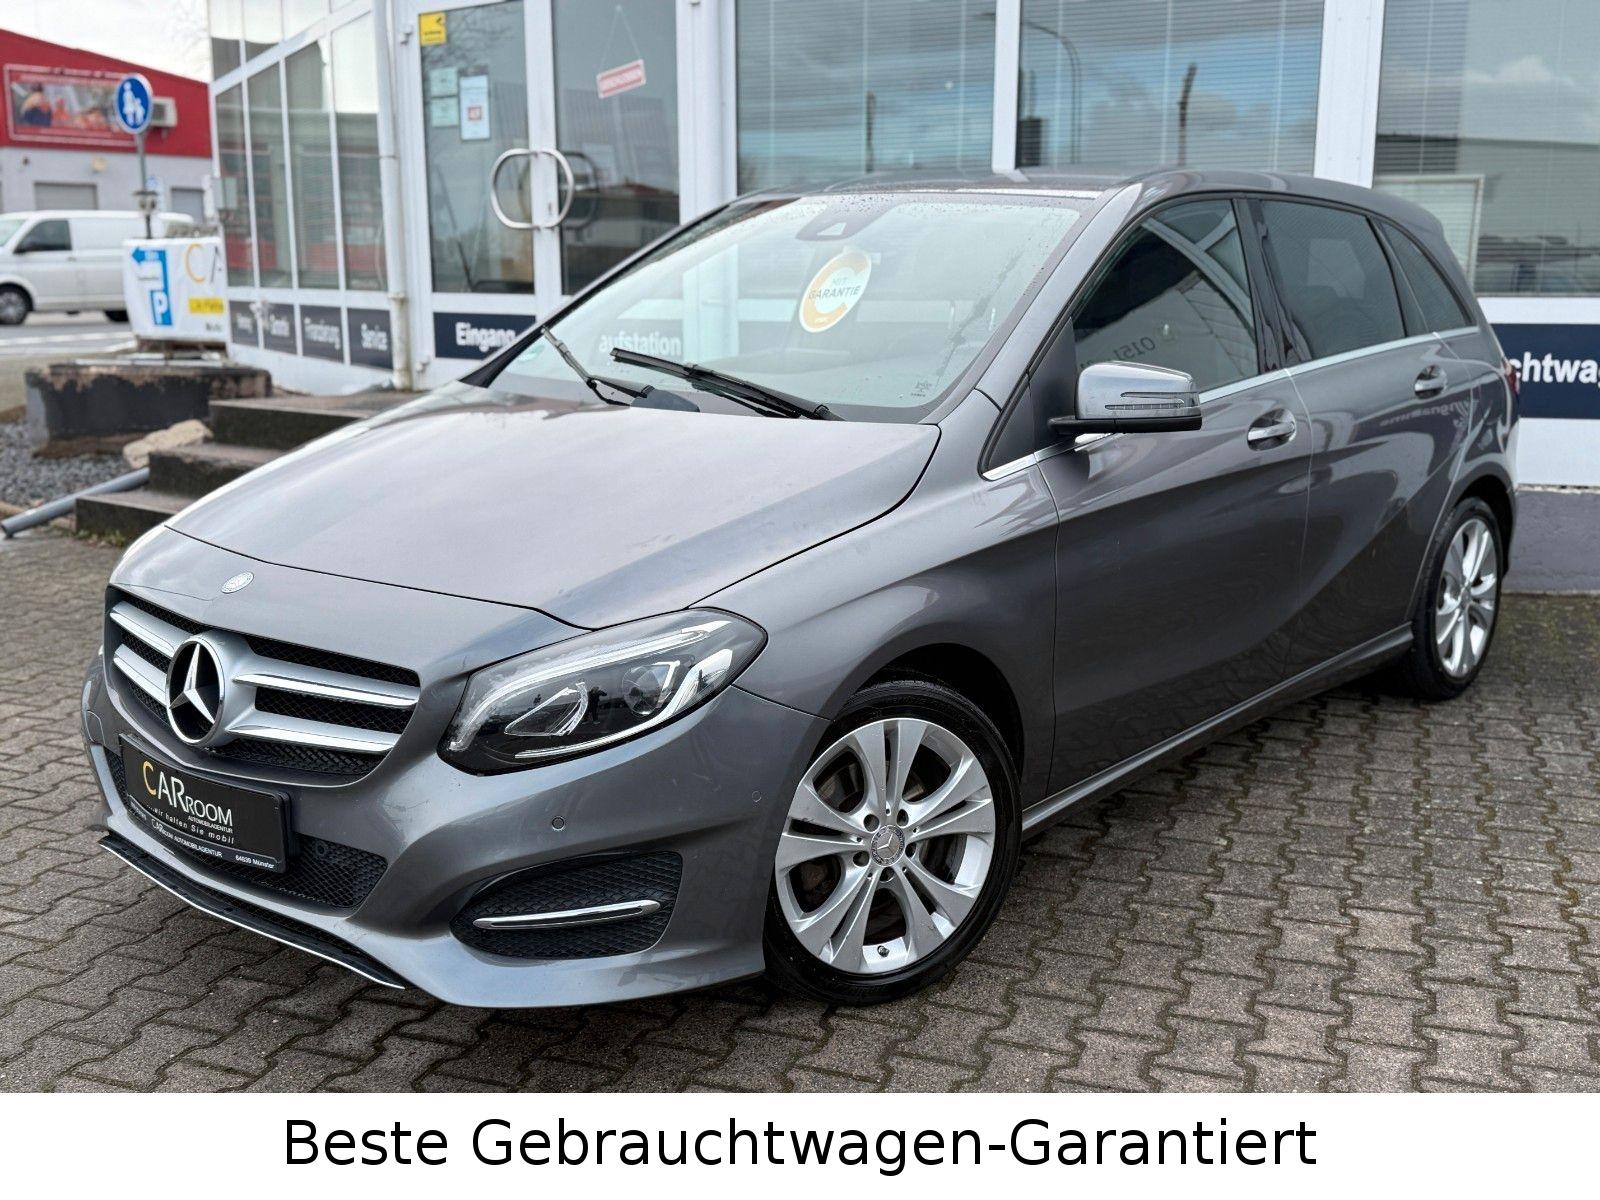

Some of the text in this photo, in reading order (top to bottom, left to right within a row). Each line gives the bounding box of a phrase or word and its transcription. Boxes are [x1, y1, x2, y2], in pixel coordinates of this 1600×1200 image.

[150, 291, 169, 323] P
[808, 285, 861, 300] GARANTIE
[1509, 351, 1600, 389] htwa
[165, 812, 188, 828] halten
[191, 824, 204, 835] Sie
[208, 831, 235, 845] mobil
